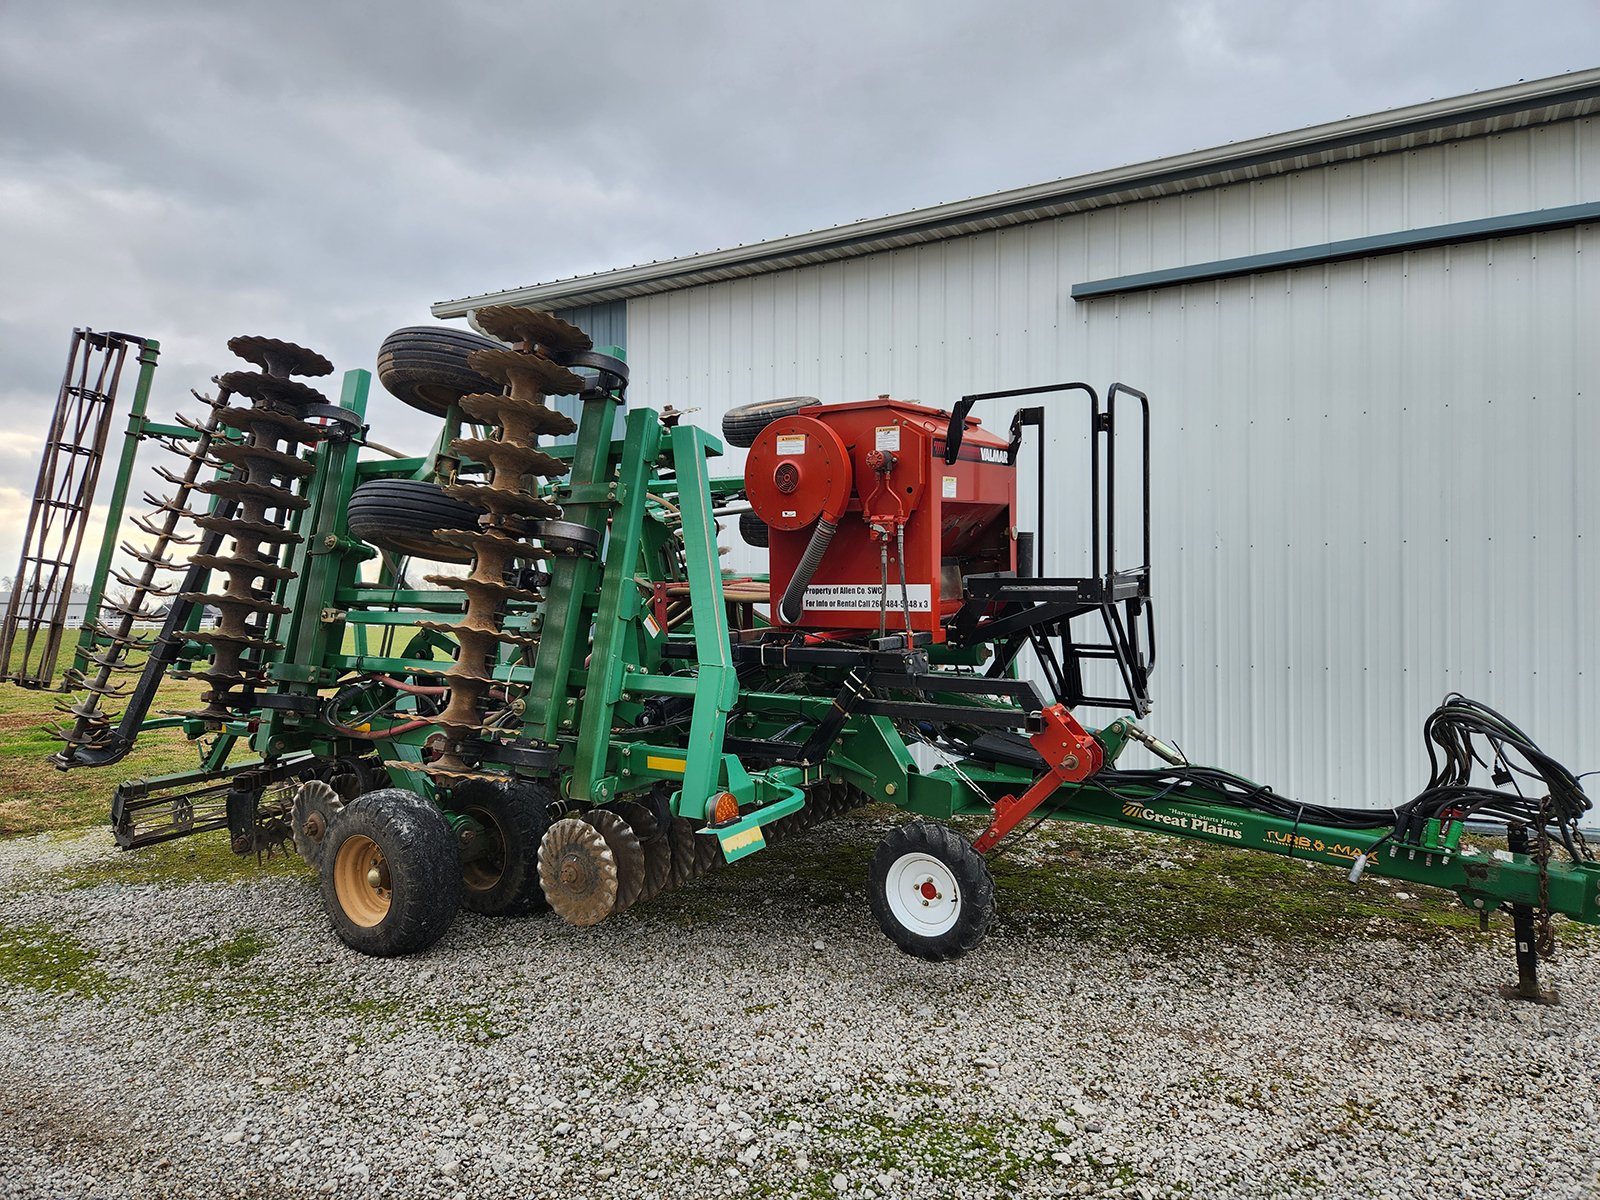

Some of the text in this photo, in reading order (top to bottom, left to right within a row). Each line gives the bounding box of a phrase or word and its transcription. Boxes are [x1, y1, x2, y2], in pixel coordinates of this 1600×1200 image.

[980, 447, 1009, 464] VALMAR
[924, 600, 929, 608] 3
[1142, 808, 1243, 840] Great Plains
